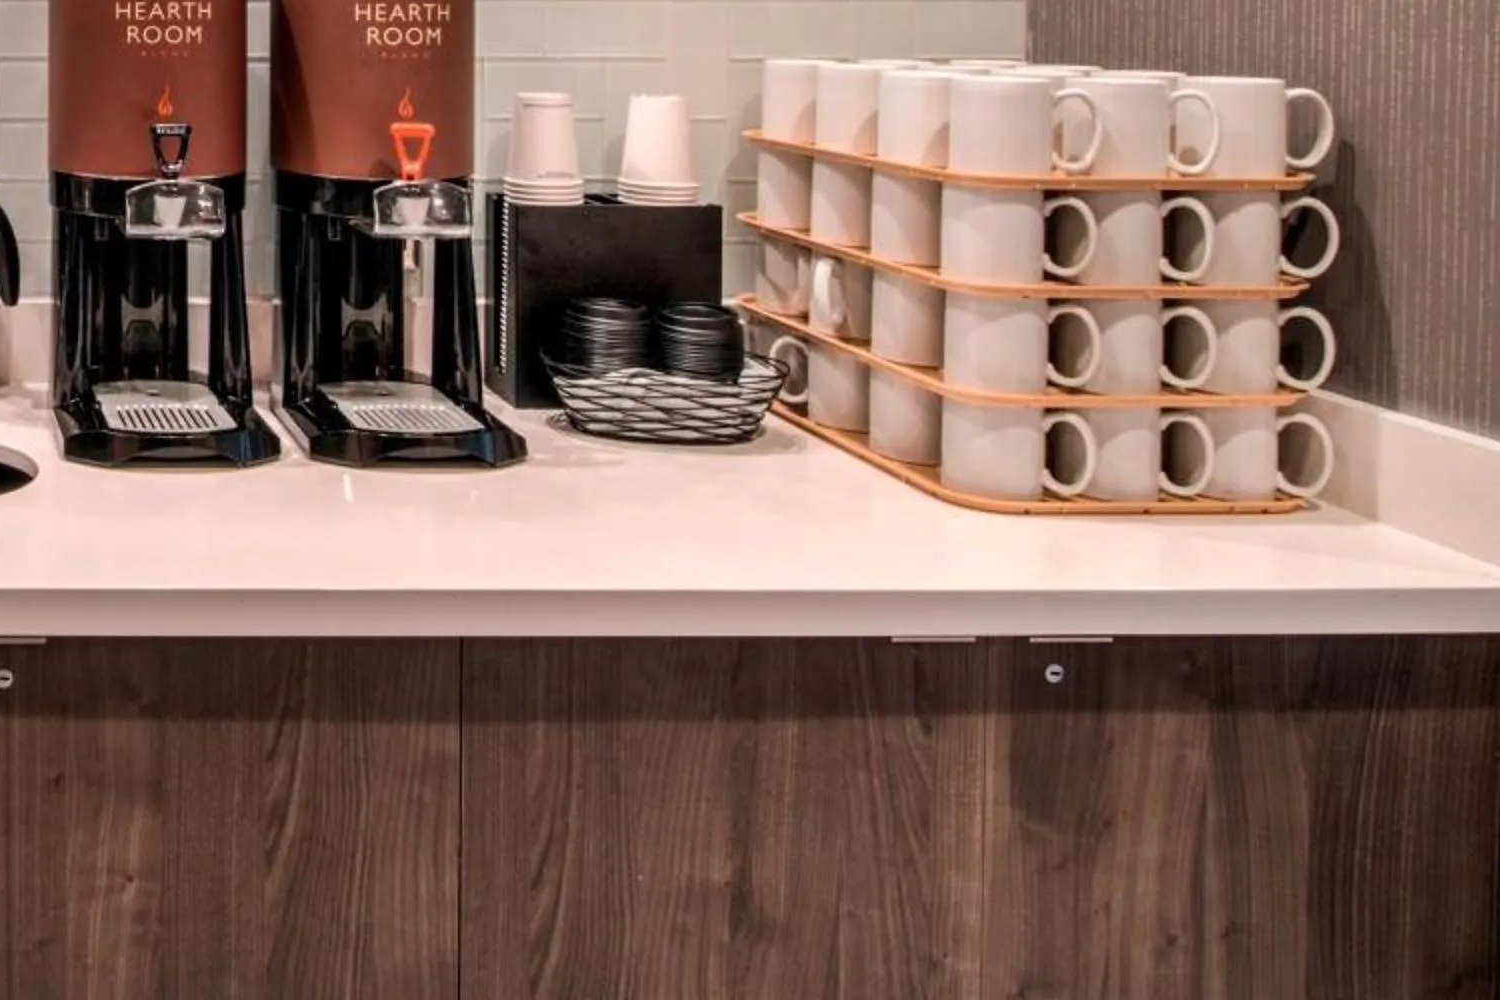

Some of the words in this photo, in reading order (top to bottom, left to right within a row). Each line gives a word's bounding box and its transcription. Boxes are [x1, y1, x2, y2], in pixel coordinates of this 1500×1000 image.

[115, 0, 212, 21] HEARTH
[355, 2, 451, 22] HEARTH
[126, 24, 203, 45] ROOM
[366, 26, 443, 46] ROOM
